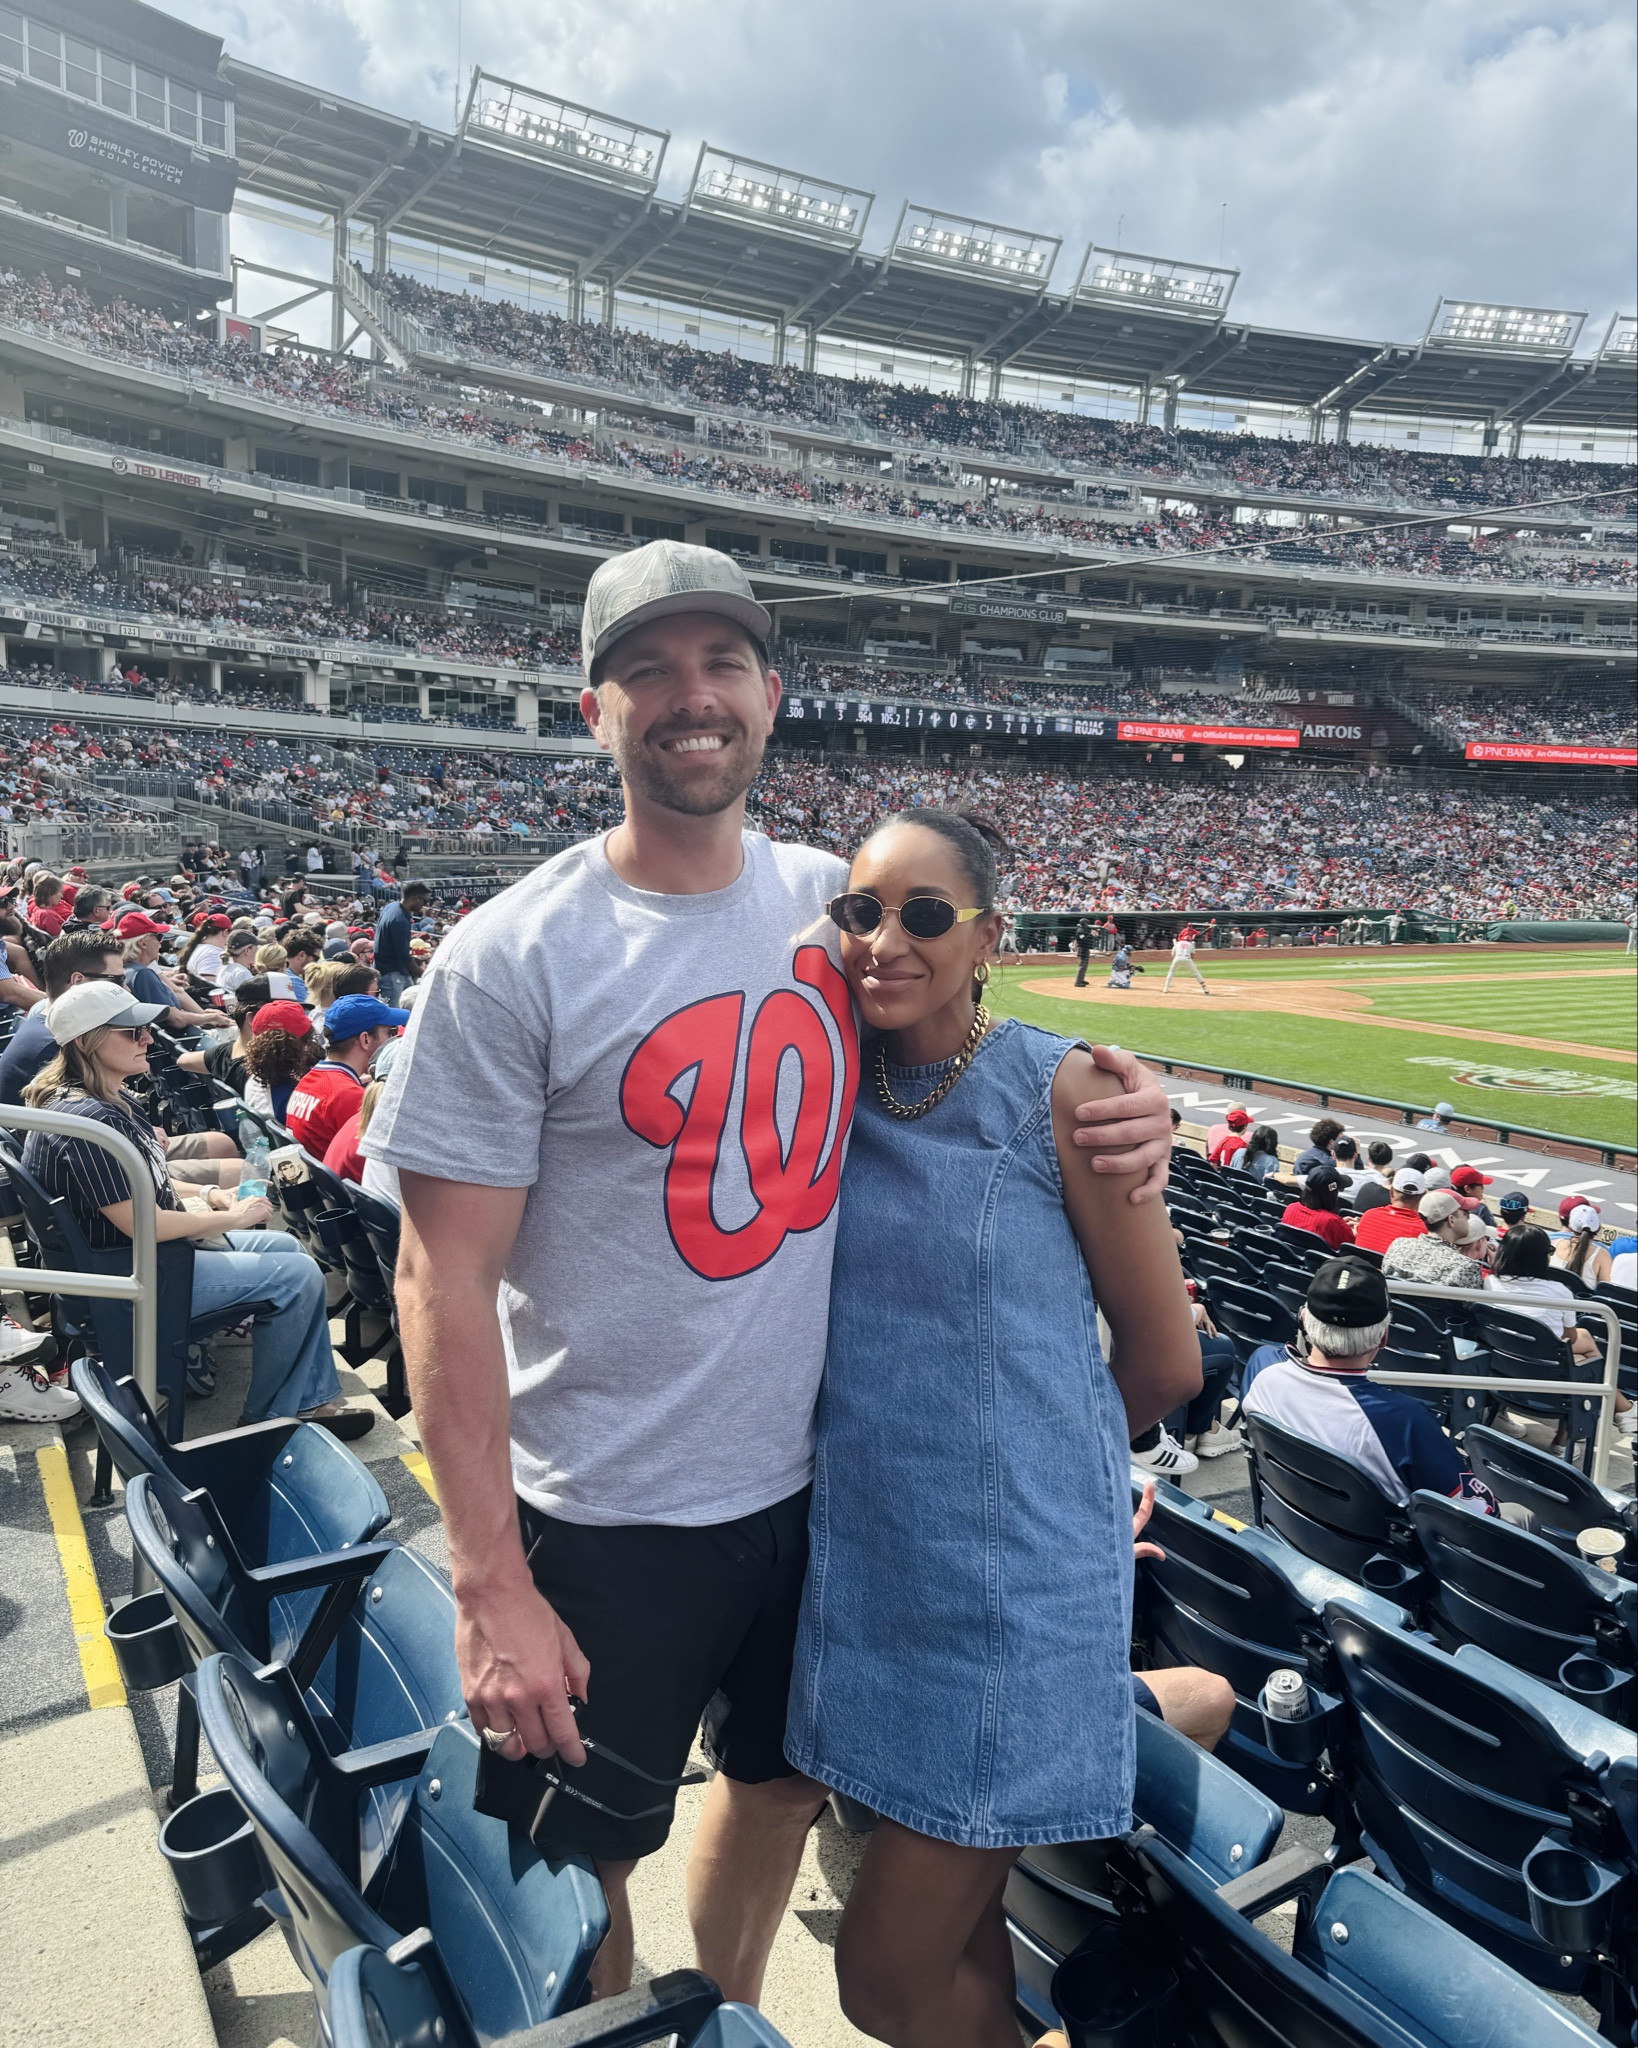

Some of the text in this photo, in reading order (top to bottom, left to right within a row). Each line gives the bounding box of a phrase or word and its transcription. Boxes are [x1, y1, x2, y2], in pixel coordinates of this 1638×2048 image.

[68, 129, 88, 148] W
[90, 136, 183, 176] SHIRLEY POVICH
[88, 145, 182, 184] MEDIA CENTER
[134, 463, 201, 486] TED LERNER
[24, 610, 72, 626] MANUSH
[953, 602, 1065, 622] FIS CHAMPIONS CLUB
[87, 620, 111, 632] RICE
[123, 627, 136, 635] 121
[165, 631, 197, 643] WYNN
[216, 638, 256, 650] CARTER
[275, 644, 316, 657] DAWSON
[326, 652, 339, 660] 120
[362, 655, 394, 667] RAINES
[786, 706, 804, 719] .300
[817, 707, 822, 719] 1
[838, 710, 844, 721] 3
[855, 711, 873, 723] .964
[881, 712, 901, 725] 105.2
[950, 712, 957, 728] 0
[986, 714, 993, 730] 5
[1005, 722, 1011, 733] 2
[1021, 723, 1027, 735] 0
[1036, 723, 1043, 735] 0
[1074, 720, 1105, 736] ROJAS
[1202, 731, 1227, 739] Official
[1228, 732, 1245, 740] Bank
[1254, 733, 1265, 741] the
[1303, 724, 1362, 740] ARTOIS
[1536, 750, 1547, 758] An
[1547, 750, 1571, 758] Official
[1610, 753, 1637, 761] National
[619, 945, 860, 1282] W
